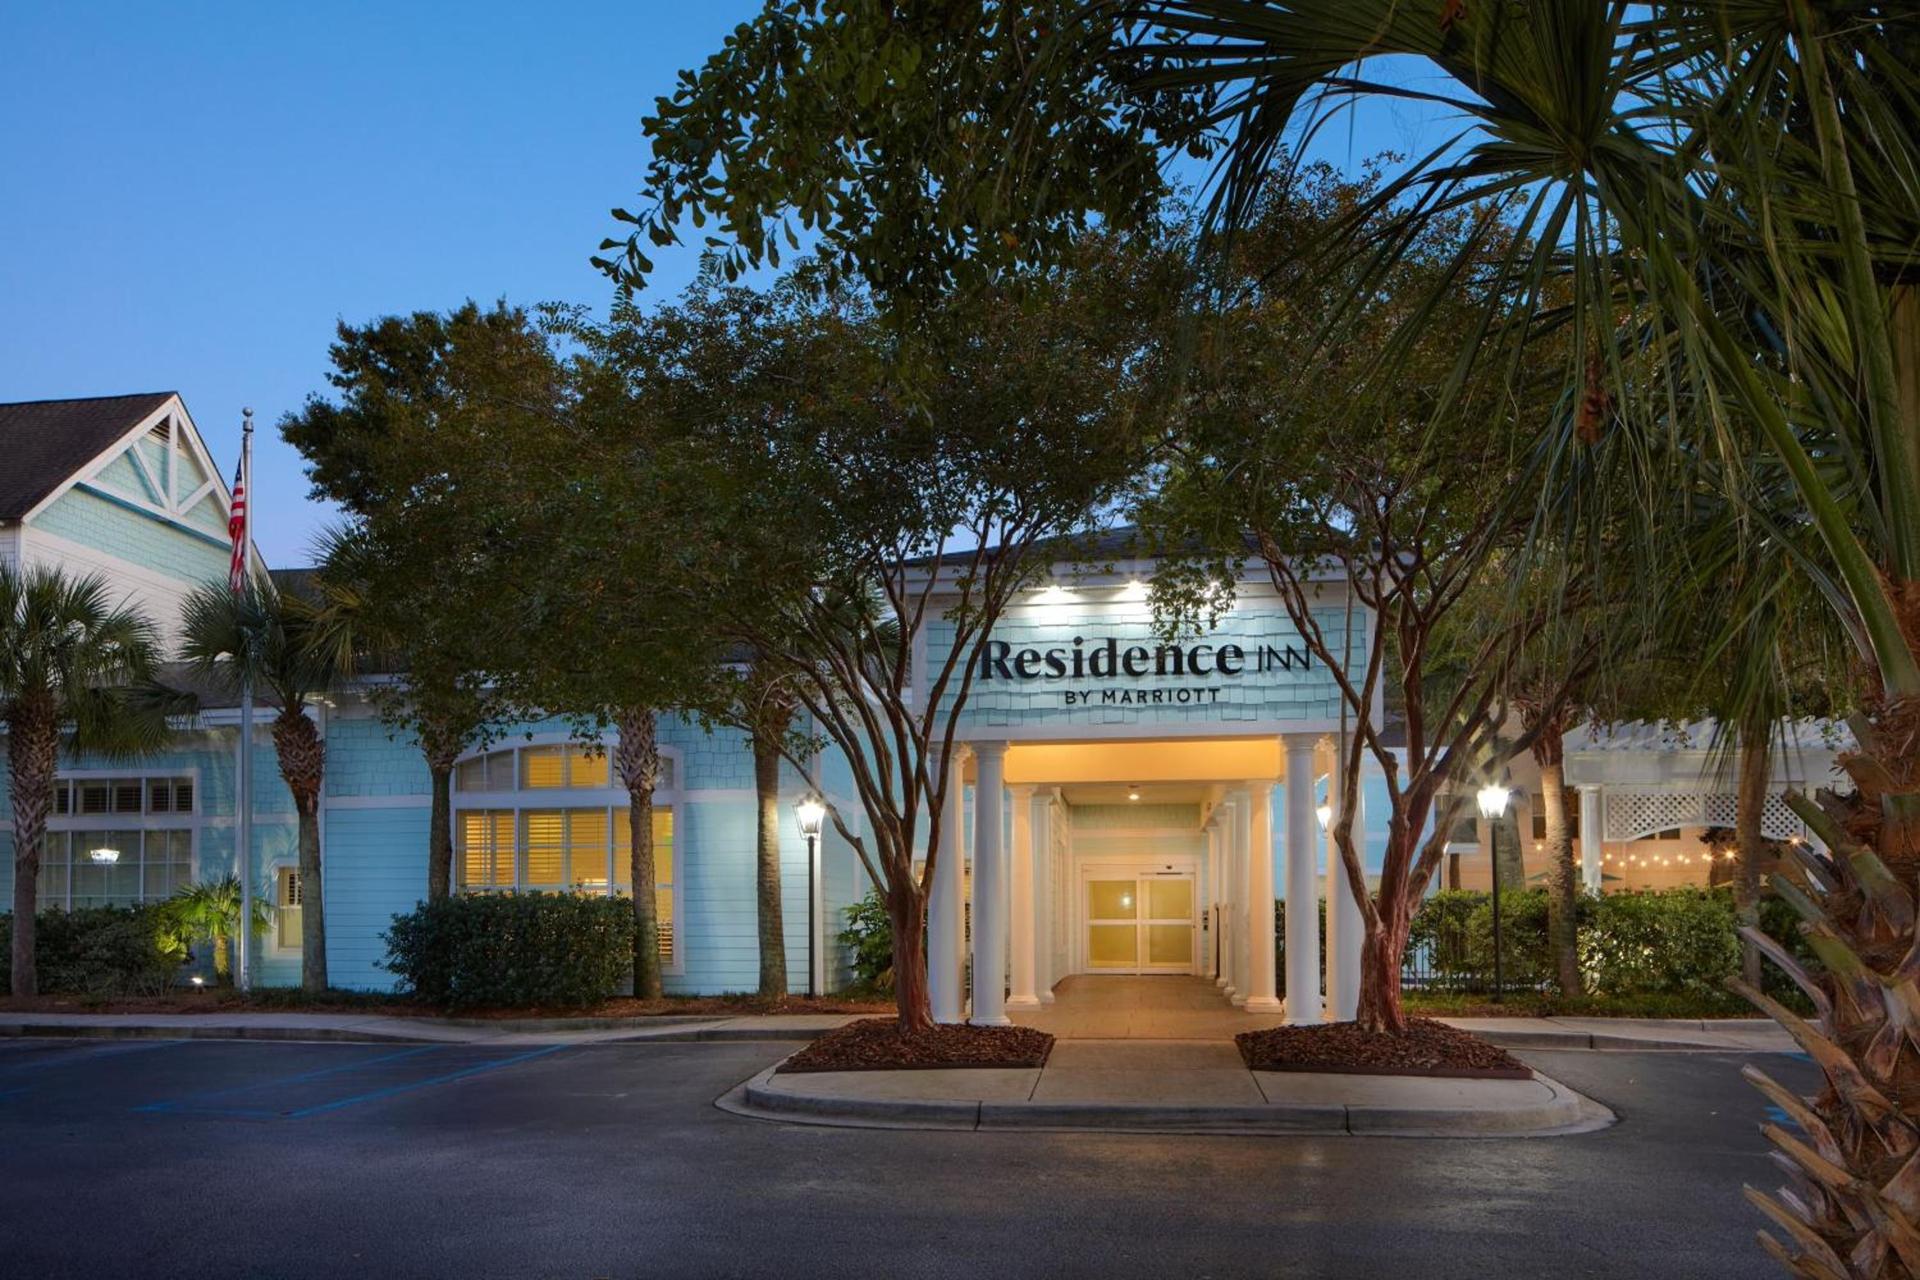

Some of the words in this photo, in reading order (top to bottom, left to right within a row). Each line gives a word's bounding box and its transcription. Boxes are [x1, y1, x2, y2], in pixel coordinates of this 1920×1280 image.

[980, 636, 1245, 680] Residence
[1257, 643, 1311, 672] INN
[1065, 690, 1090, 705] BY
[1102, 687, 1221, 704] MARRIOTT
